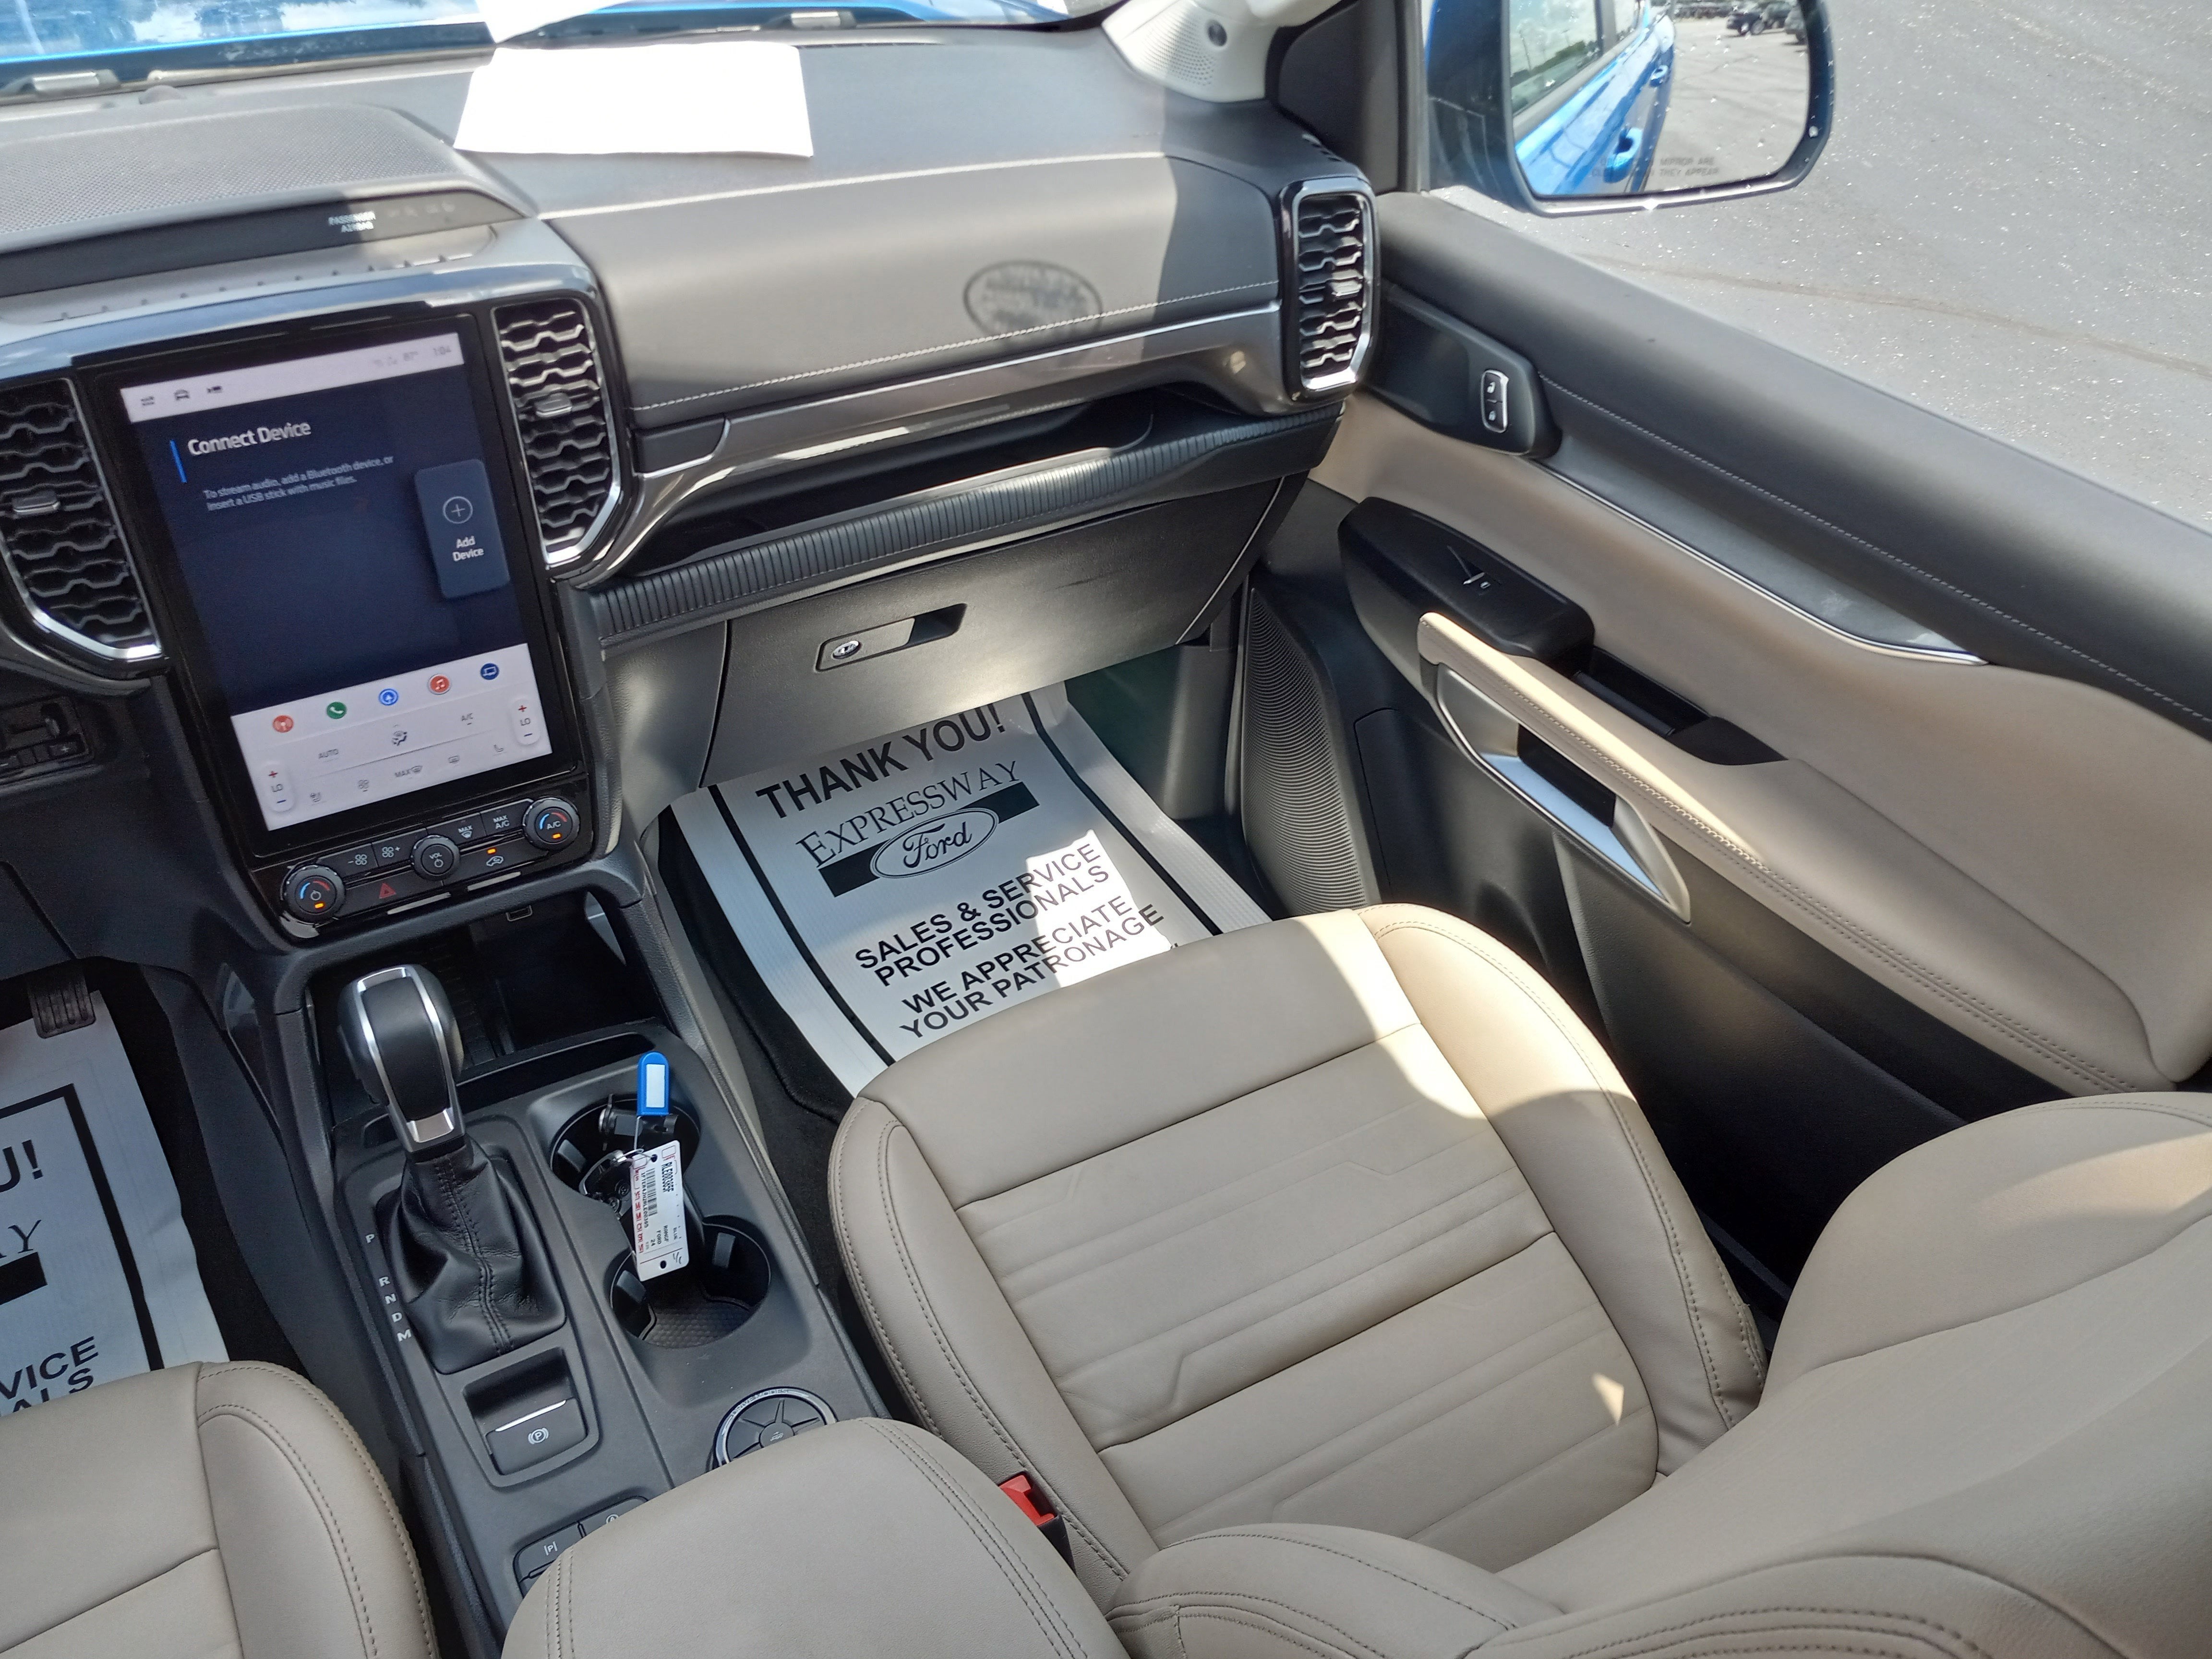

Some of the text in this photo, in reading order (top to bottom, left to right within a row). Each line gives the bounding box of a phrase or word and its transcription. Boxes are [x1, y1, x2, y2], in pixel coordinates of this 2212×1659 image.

[188, 422, 311, 455] Connect Device
[203, 490, 217, 499] To
[217, 485, 251, 497] stream
[281, 473, 300, 484] add
[306, 463, 352, 479] Bluetooth
[242, 493, 264, 504] USB
[264, 488, 287, 500] stick
[286, 484, 309, 495] with
[309, 480, 335, 491] music
[457, 535, 476, 548] Add
[452, 548, 484, 562] Device
[318, 713, 474, 759] AUTO A/C
[755, 703, 1005, 818] THANK YOU!
[395, 769, 410, 777] MAX
[493, 815, 508, 823] MAX
[495, 821, 510, 830] A/C
[547, 821, 561, 830] A/C
[458, 825, 473, 833] MAX
[902, 821, 973, 868] Ford
[855, 843, 1101, 969] SALES & SERVICE
[874, 866, 1109, 987] PROFESSIONALS
[902, 896, 1132, 1014] WE APPRECIATE
[899, 903, 1164, 1038] YOUR PATRONAGE
[365, 1233, 375, 1244] P
[379, 1276, 391, 1287] R
[385, 1293, 397, 1305] N
[392, 1312, 403, 1322] D
[397, 1329, 412, 1342] M
